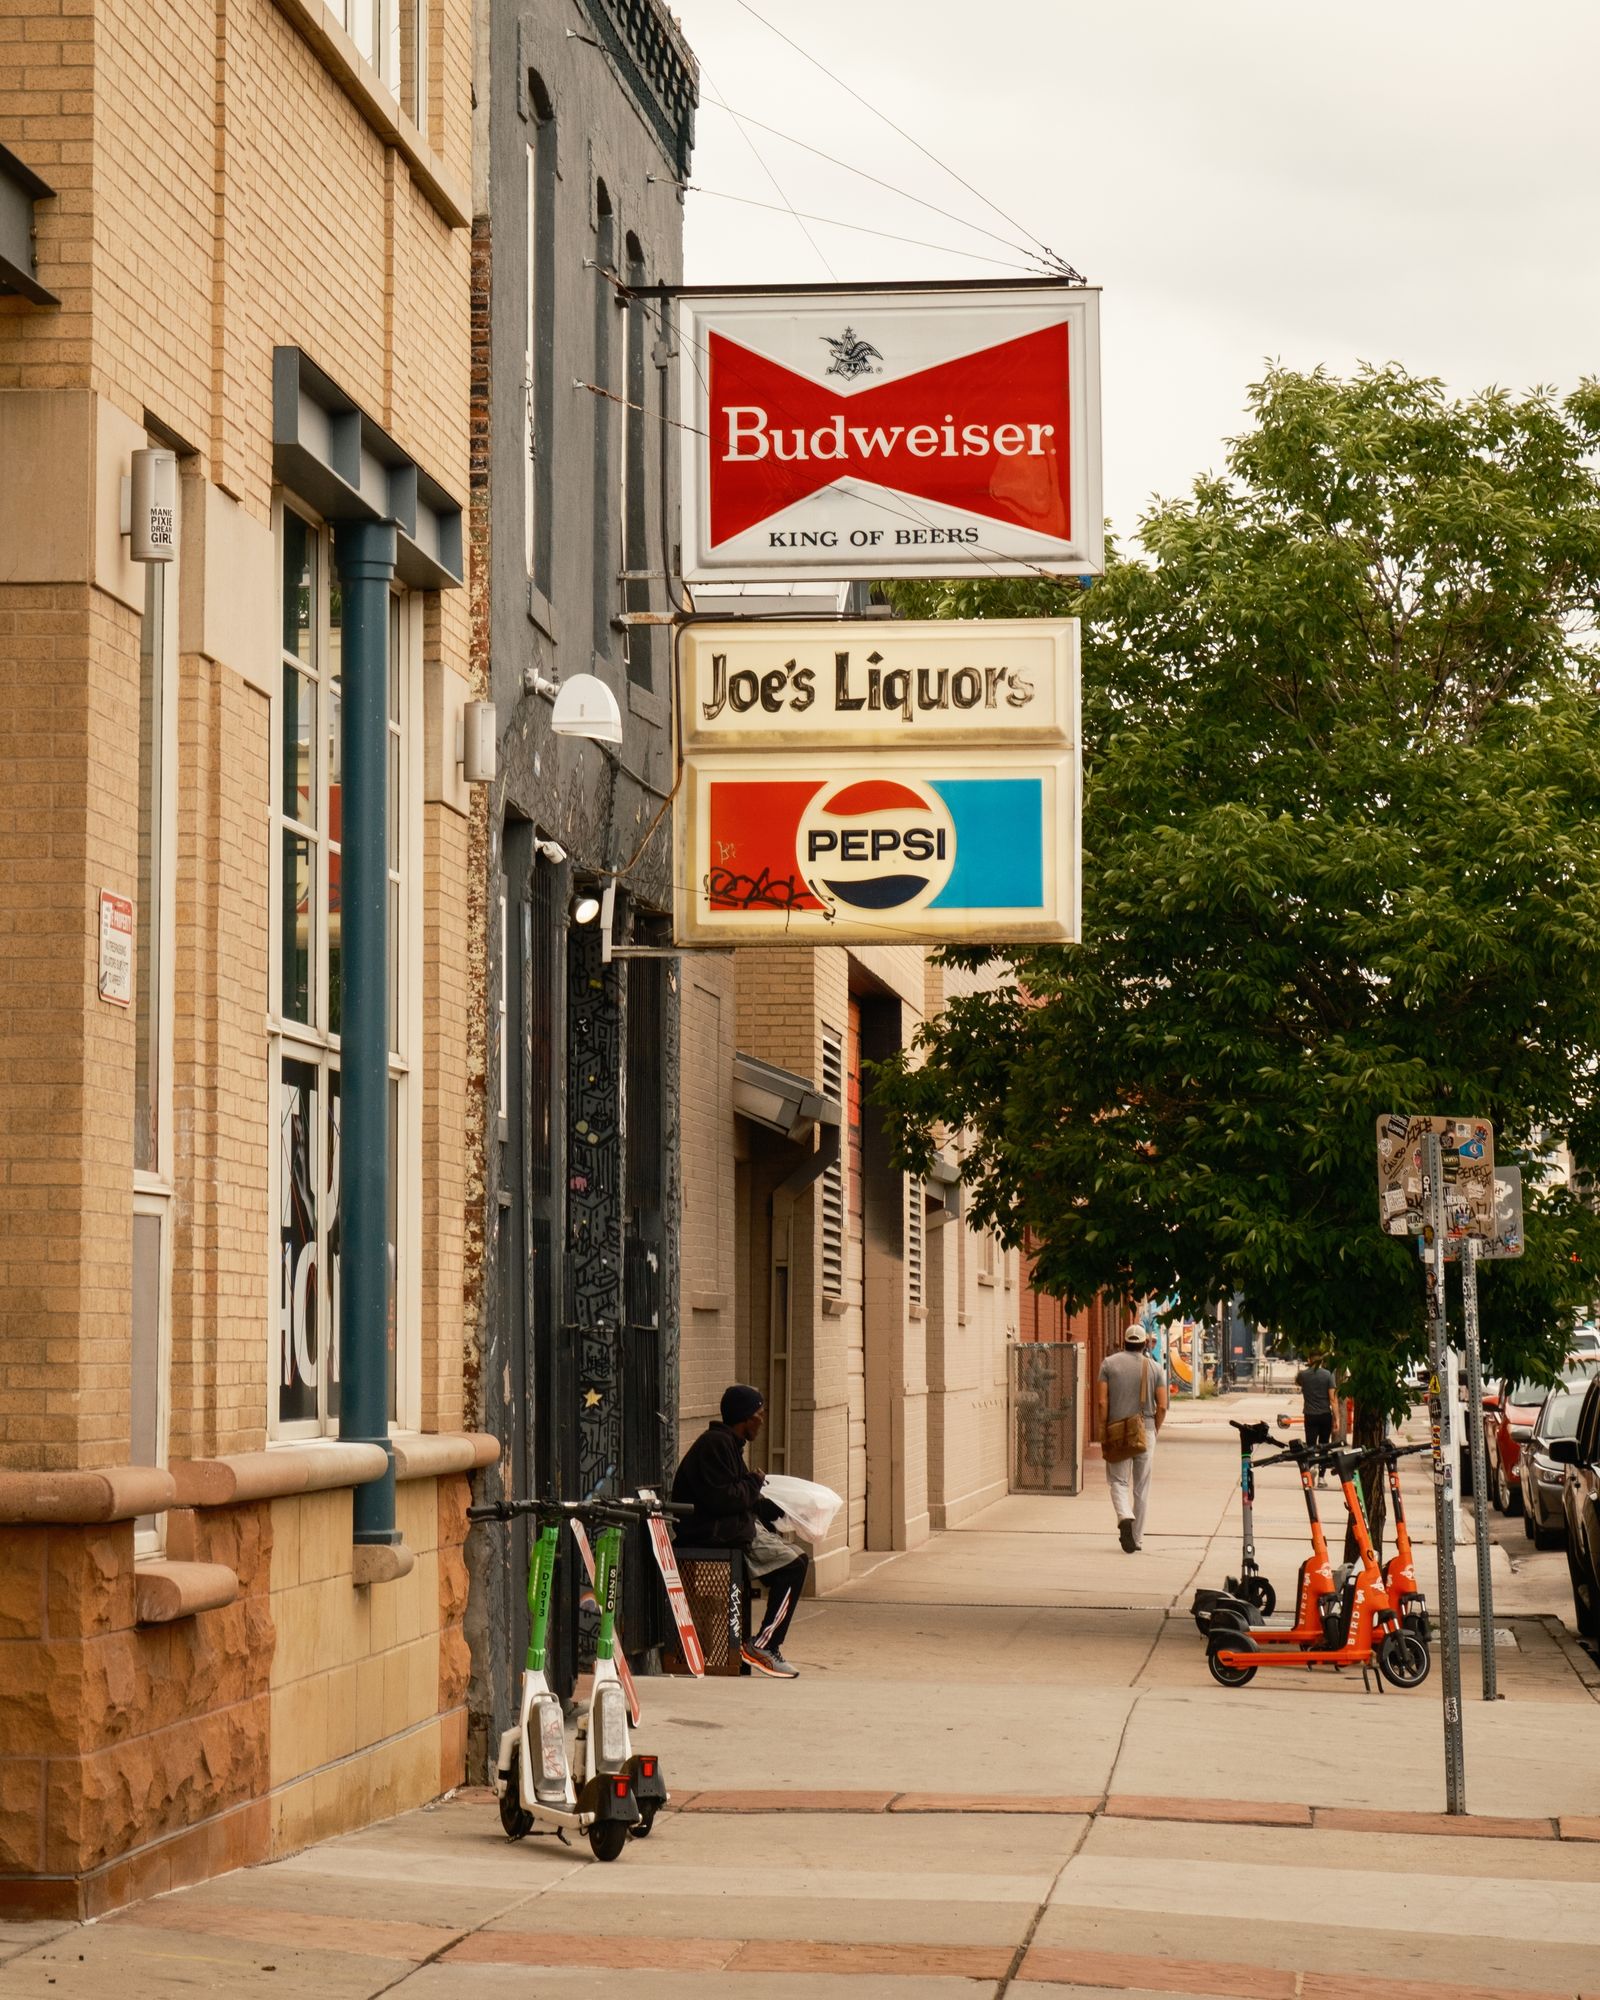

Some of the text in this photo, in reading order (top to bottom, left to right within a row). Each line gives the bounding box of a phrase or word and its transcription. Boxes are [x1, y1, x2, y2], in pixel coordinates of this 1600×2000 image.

[721, 405, 1055, 462] Budweiser
[151, 508, 173, 517] MANIC
[151, 516, 172, 526] PIXIE
[151, 533, 172, 544] GIRL
[768, 527, 979, 548] KING OF BEERS
[702, 651, 1035, 723] Joe's Liquors
[808, 828, 946, 862] PEPSI
[538, 1572, 550, 1617] D1913
[607, 1568, 617, 1610] 8220
[1347, 1611, 1360, 1645] BIRD
